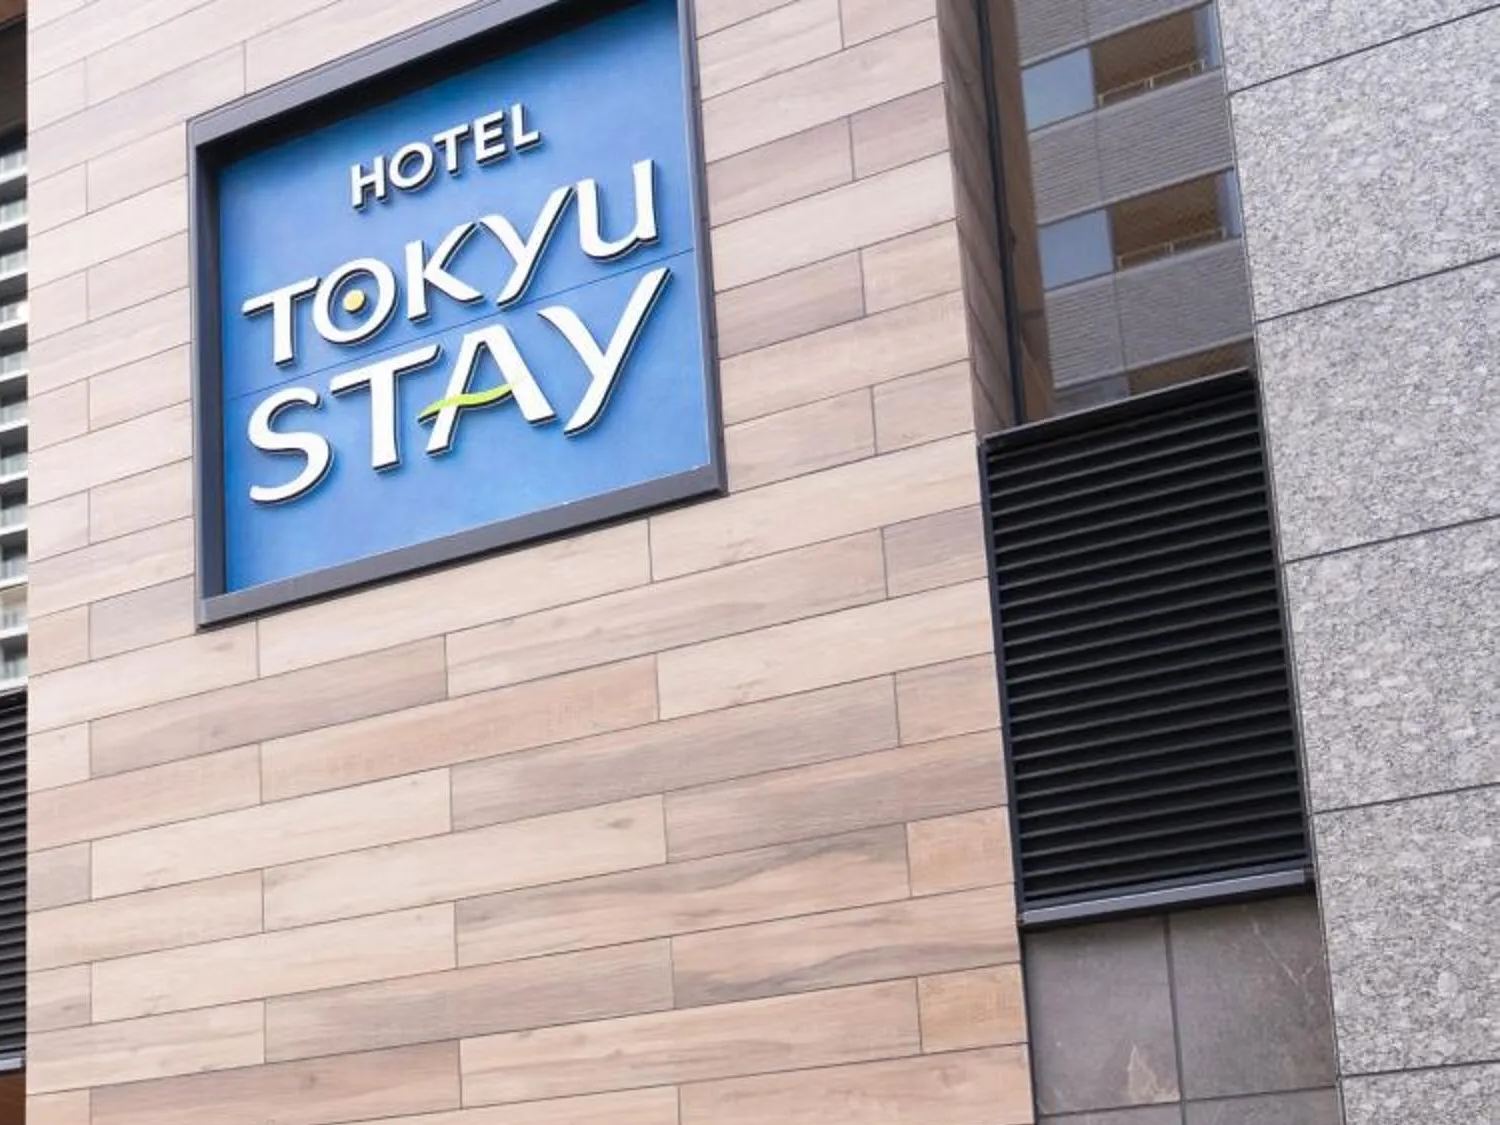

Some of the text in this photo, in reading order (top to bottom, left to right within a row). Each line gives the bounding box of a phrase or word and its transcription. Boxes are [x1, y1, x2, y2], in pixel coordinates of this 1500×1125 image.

[351, 103, 541, 210] HOTEL
[242, 159, 658, 367] TOKYU
[247, 267, 671, 504] STAY
